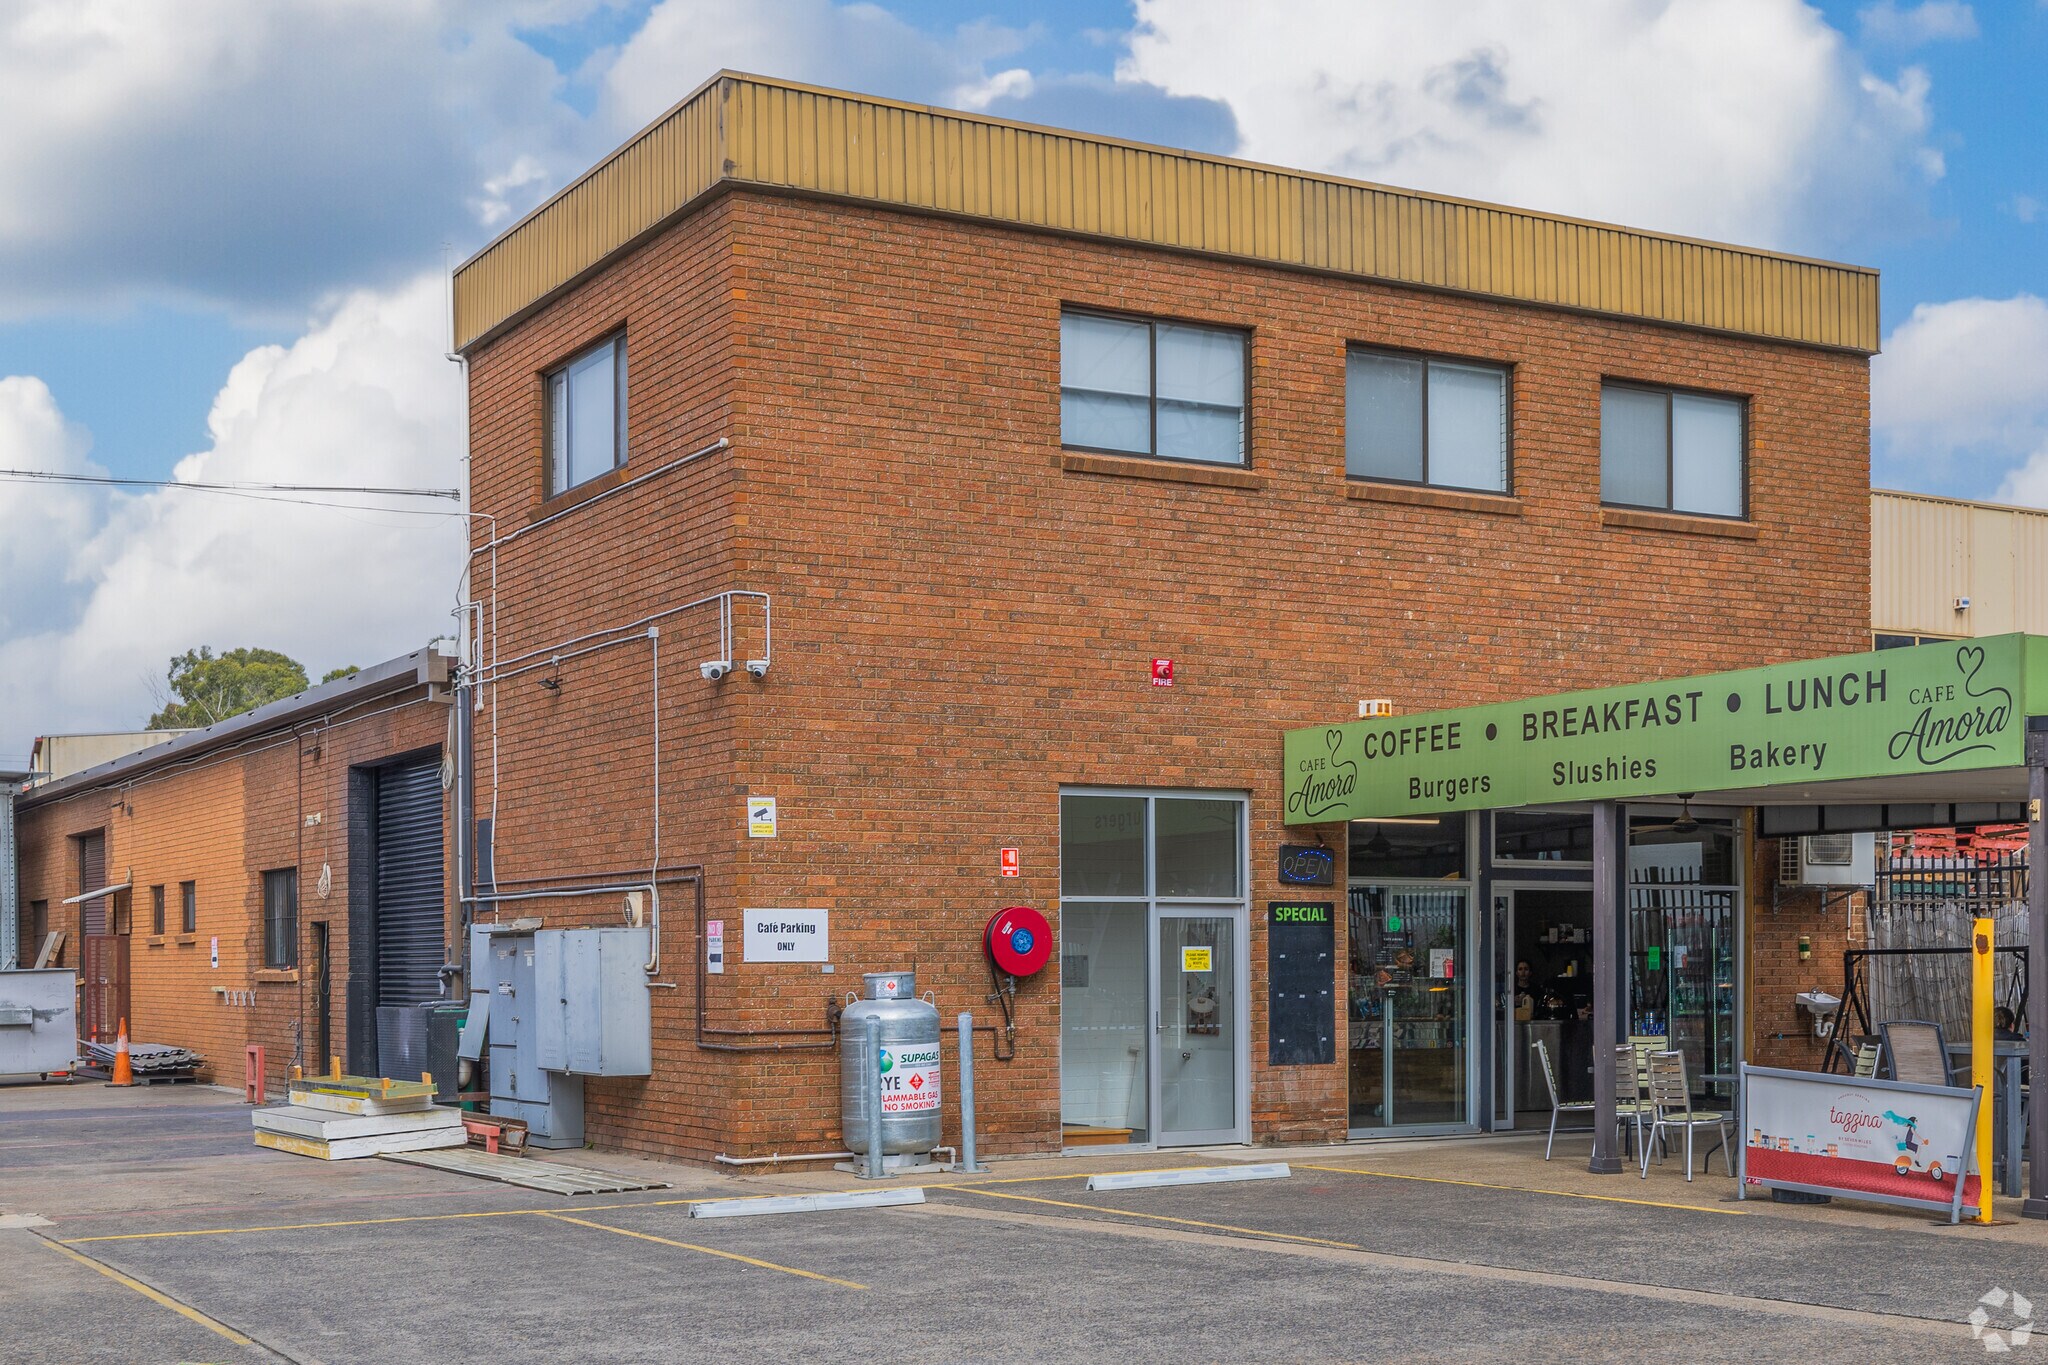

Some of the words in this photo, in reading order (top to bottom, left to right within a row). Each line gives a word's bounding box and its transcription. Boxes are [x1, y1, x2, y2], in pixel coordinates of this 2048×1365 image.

[1152, 677, 1173, 686] FIRE
[1909, 685, 1955, 705] CAFE
[1364, 722, 1461, 759] COFFEE
[1522, 690, 1703, 741] BREAKFAST
[1765, 669, 1887, 714] LUNCH
[1888, 703, 2010, 766] Amora
[1300, 757, 1326, 773] CAFE
[1409, 775, 1491, 802] Burgers
[1553, 755, 1657, 787] Slushies
[1730, 742, 1827, 771] Bakery
[1288, 772, 1356, 818] Amora
[1283, 856, 1330, 875] OPEN
[1275, 907, 1327, 922] SPECIAL
[757, 922, 778, 933] Café
[780, 922, 816, 934] Parking
[777, 941, 795, 951] ONLY
[901, 1051, 939, 1063] SUPAGAS
[880, 1076, 900, 1090] YE
[882, 1093, 926, 1102] LAMMABLE
[928, 1091, 938, 1099] GAS
[884, 1103, 898, 1111] NO
[901, 1100, 935, 1110] SMOKING
[1830, 1105, 1883, 1133] tazzina
